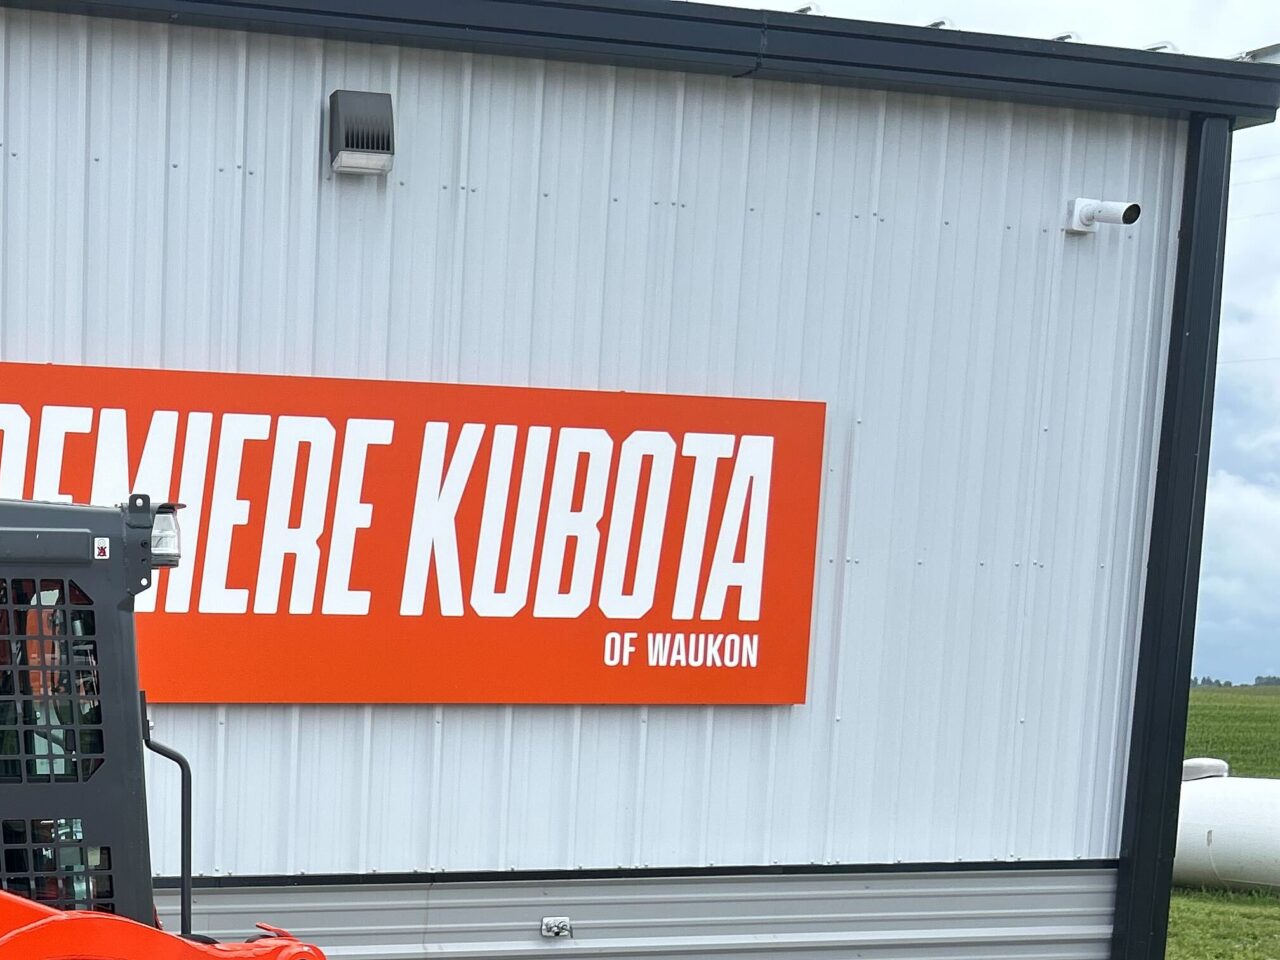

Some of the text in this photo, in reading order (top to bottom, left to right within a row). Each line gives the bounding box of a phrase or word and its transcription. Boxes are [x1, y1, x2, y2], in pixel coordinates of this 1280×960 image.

[400, 421, 775, 621] KUBOTA
[605, 631, 759, 668] OF WAUKON
